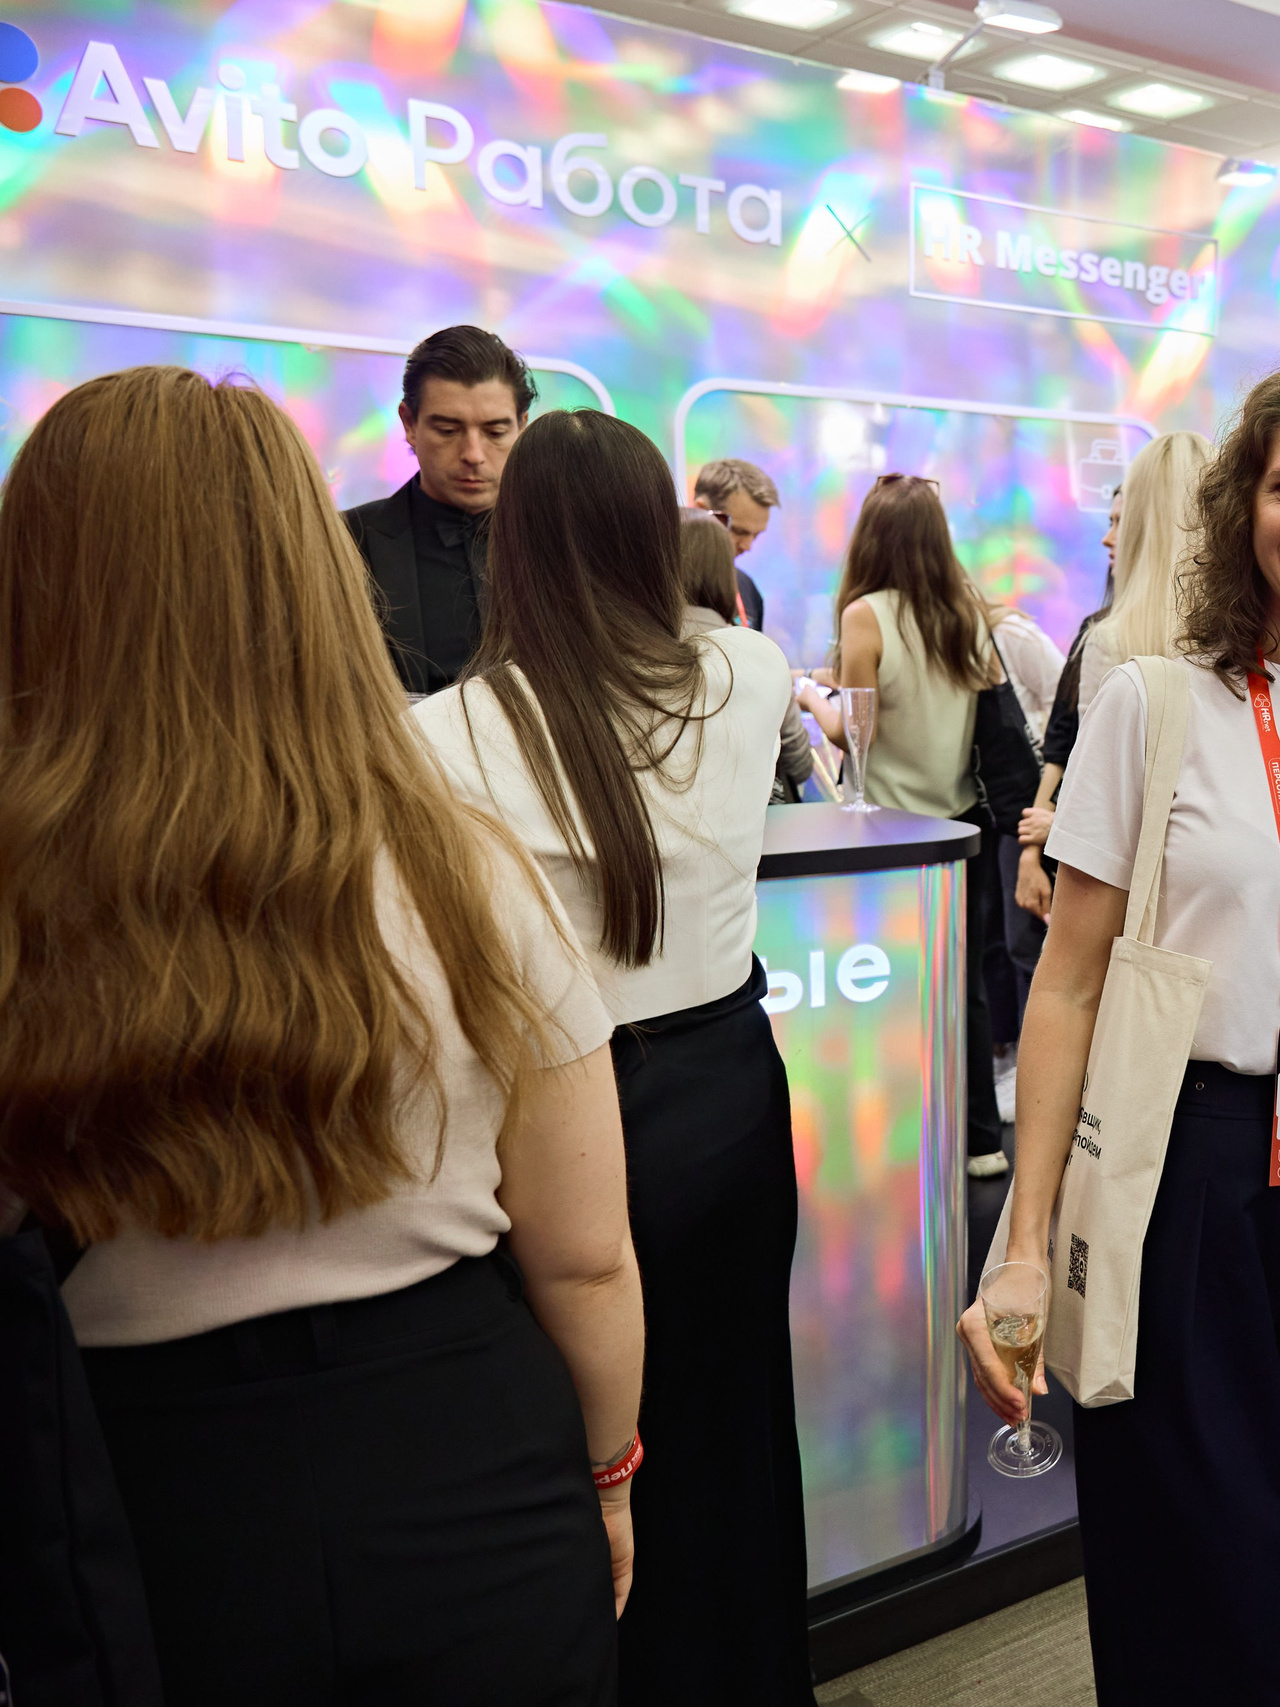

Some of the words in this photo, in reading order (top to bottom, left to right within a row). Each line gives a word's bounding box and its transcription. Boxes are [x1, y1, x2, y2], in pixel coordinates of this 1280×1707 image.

[54, 41, 368, 178] Avito
[406, 99, 782, 246] Работа
[922, 219, 983, 267] HR
[996, 230, 1212, 303] Messenger
